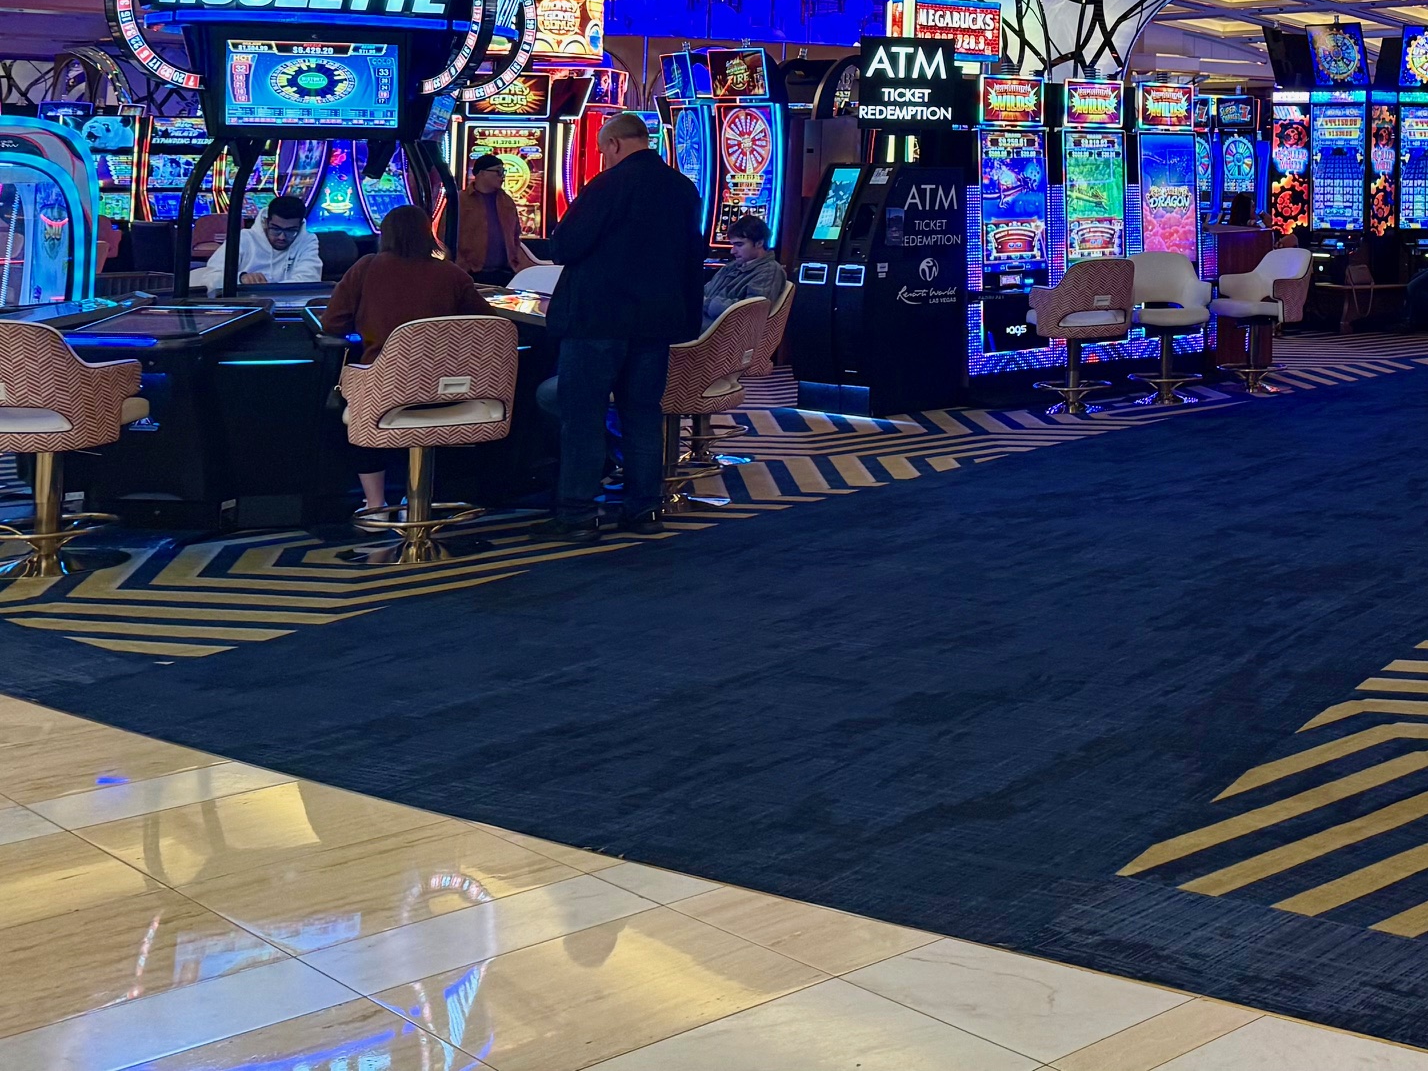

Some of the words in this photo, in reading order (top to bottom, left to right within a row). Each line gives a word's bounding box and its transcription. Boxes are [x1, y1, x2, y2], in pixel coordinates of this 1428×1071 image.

[918, 9, 995, 30] MEGABUCKS
[865, 45, 947, 80] ATM
[881, 88, 932, 102] TICKET
[859, 105, 952, 121] REDEMPTION
[904, 184, 958, 210] ATM
[1150, 196, 1190, 208] DRAGON
[914, 220, 948, 231] TICKET
[902, 234, 961, 246] EDEMPTION
